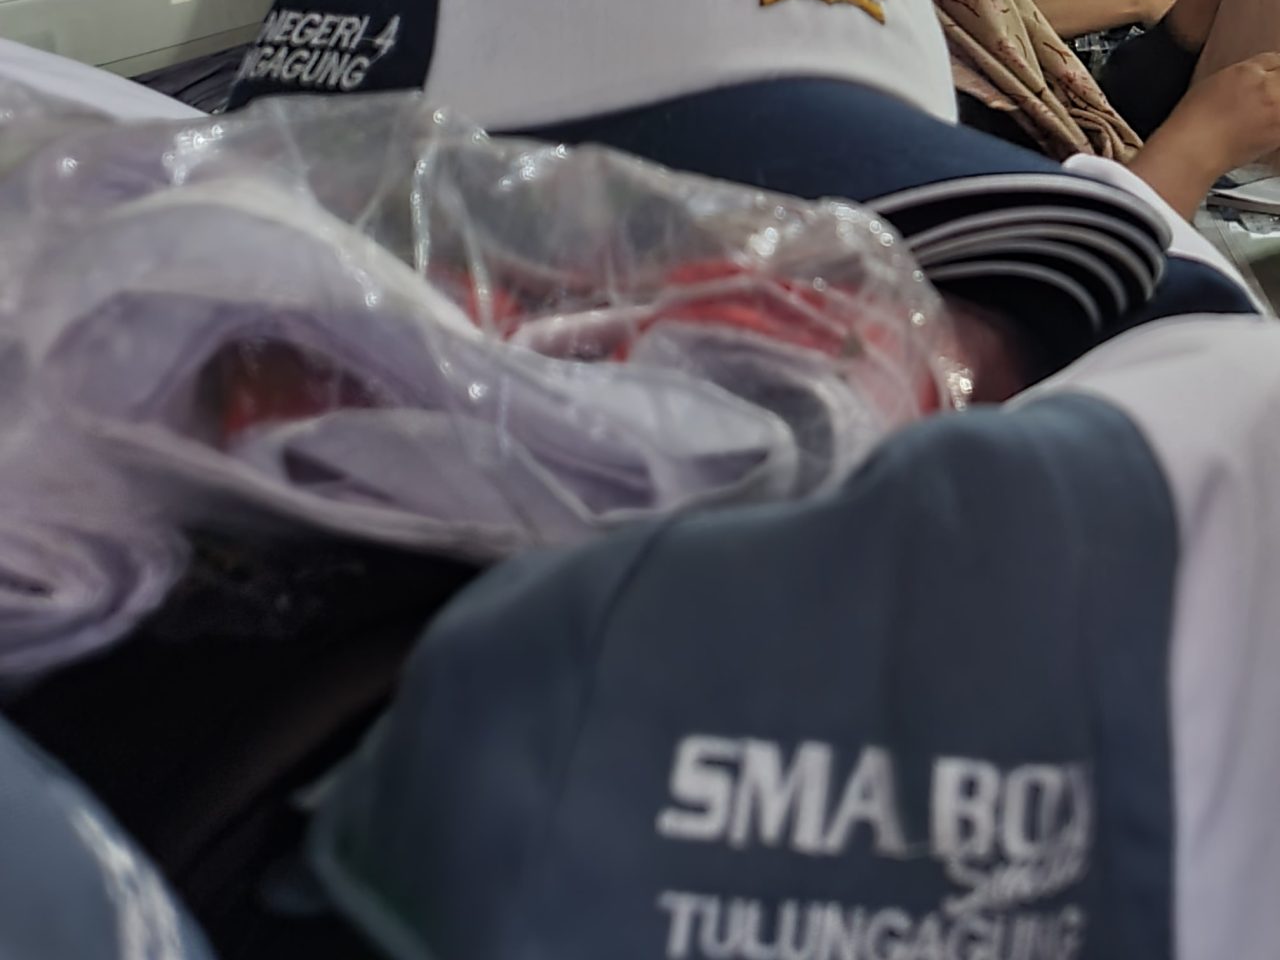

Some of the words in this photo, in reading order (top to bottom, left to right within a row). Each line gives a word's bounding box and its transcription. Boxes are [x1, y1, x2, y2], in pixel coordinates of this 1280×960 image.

[257, 9, 371, 50] NEGERI
[373, 14, 401, 56] 4
[656, 733, 906, 858] SMA
